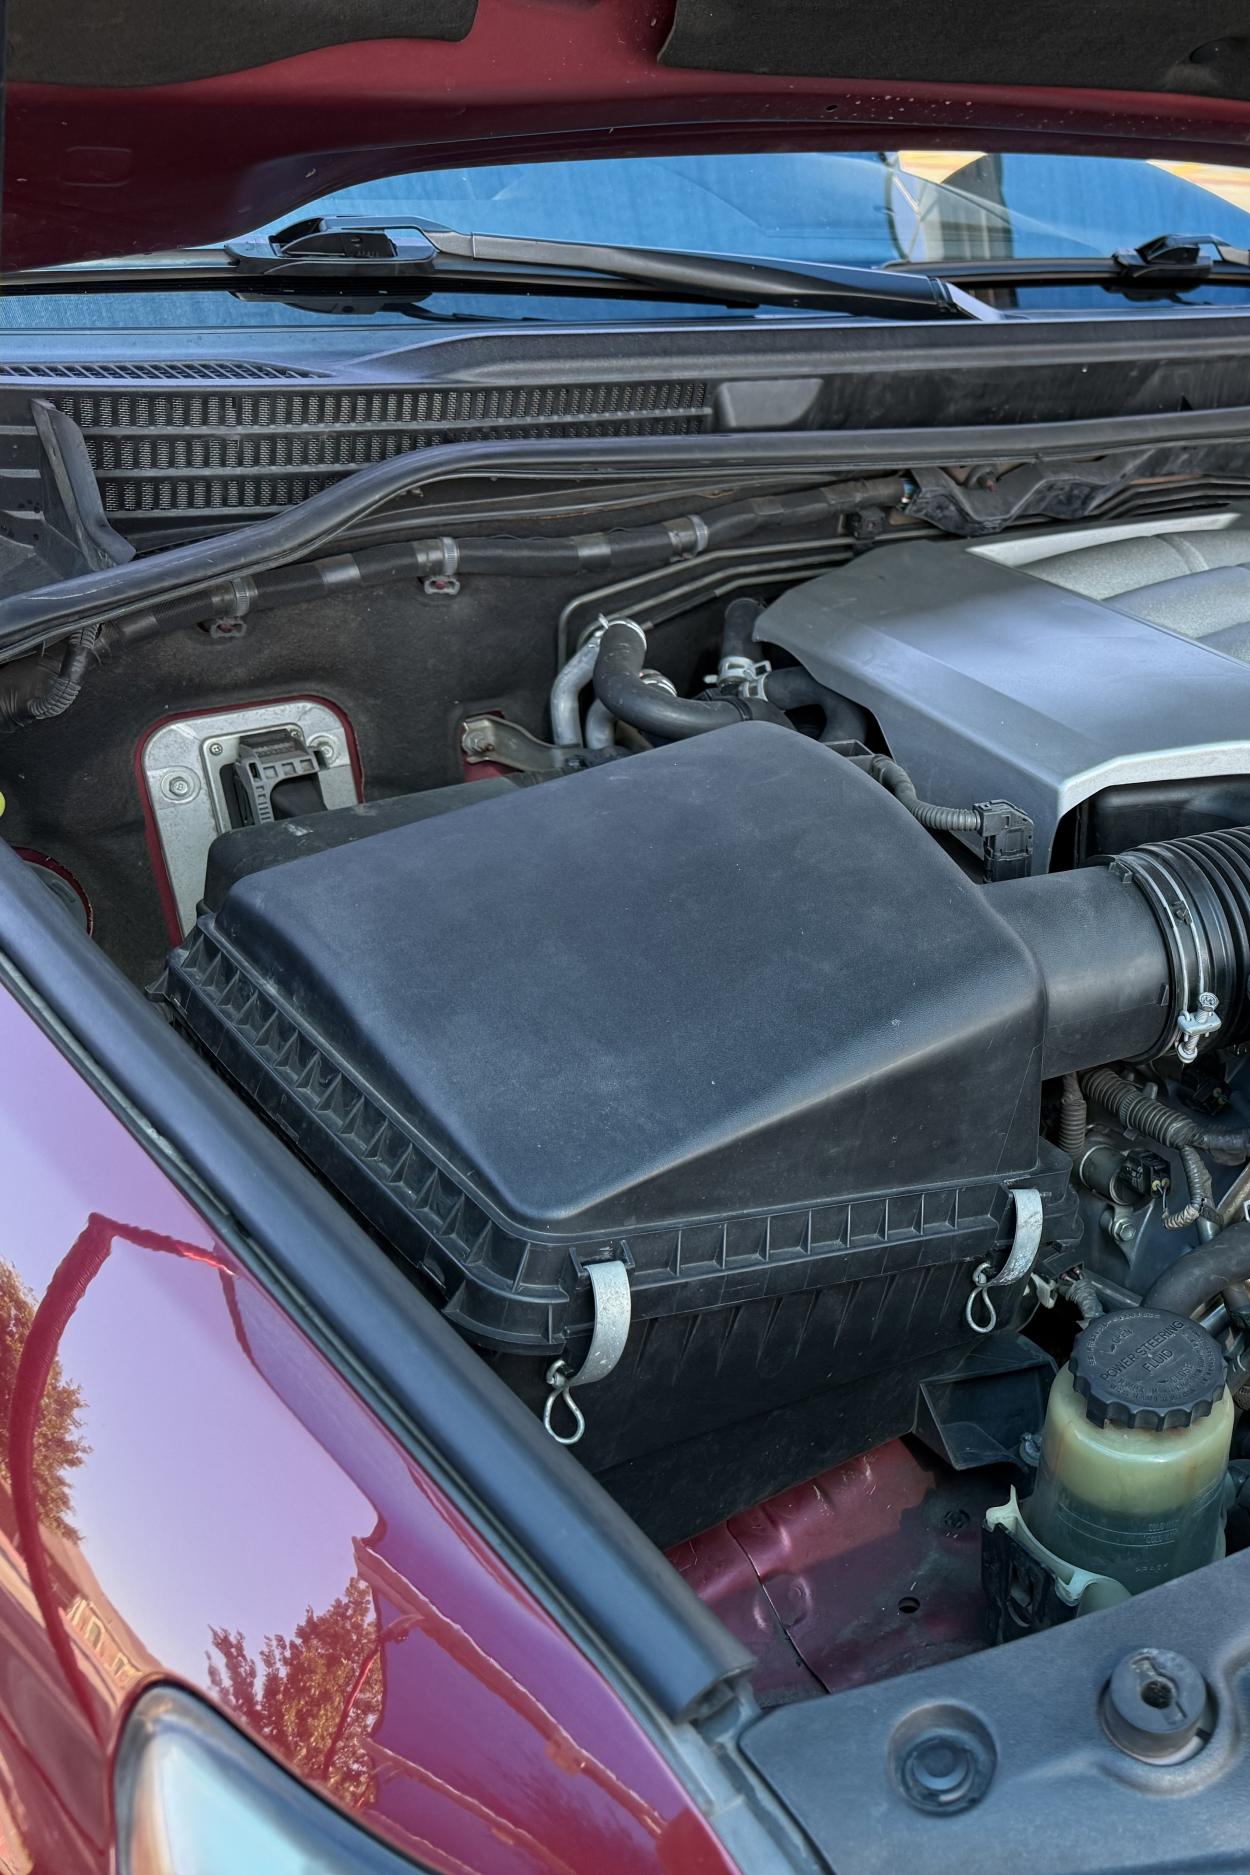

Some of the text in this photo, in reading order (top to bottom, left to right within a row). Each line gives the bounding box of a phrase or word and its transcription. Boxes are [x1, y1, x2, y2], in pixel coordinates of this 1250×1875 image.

[1100, 1353, 1138, 1382] POWER
[1135, 1320, 1184, 1358] STEERING
[1141, 1349, 1173, 1375] FLUID
